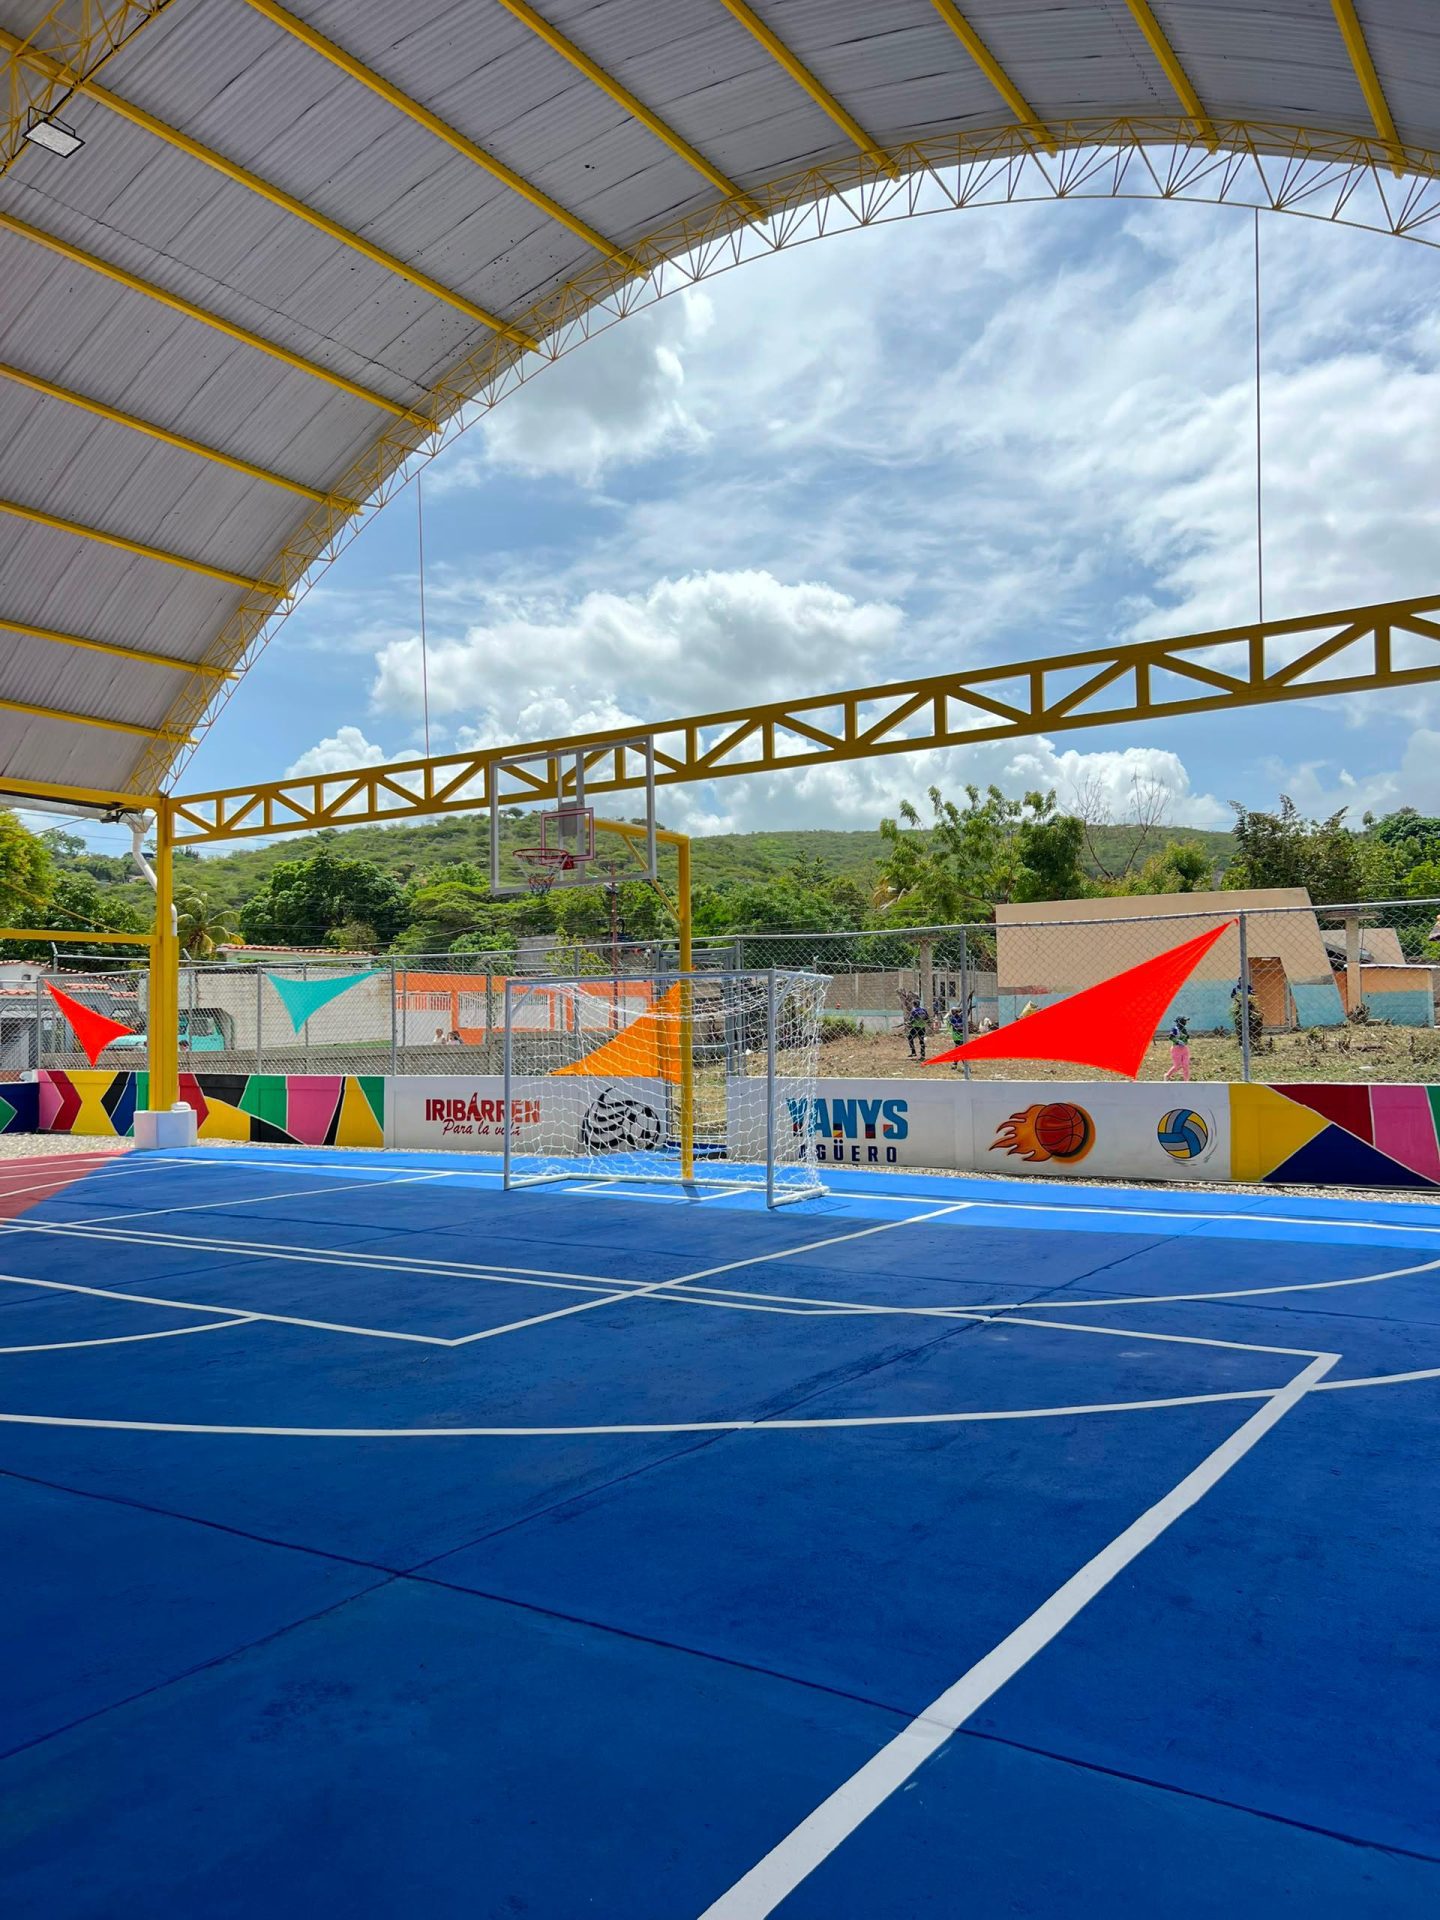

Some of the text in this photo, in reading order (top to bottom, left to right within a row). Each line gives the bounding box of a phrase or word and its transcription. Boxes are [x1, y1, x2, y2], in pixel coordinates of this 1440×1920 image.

[442, 1118, 474, 1136] Para
[477, 1120, 490, 1135] la
[785, 1097, 908, 1140] YANYS
[798, 1138, 897, 1163] AGÜERO
